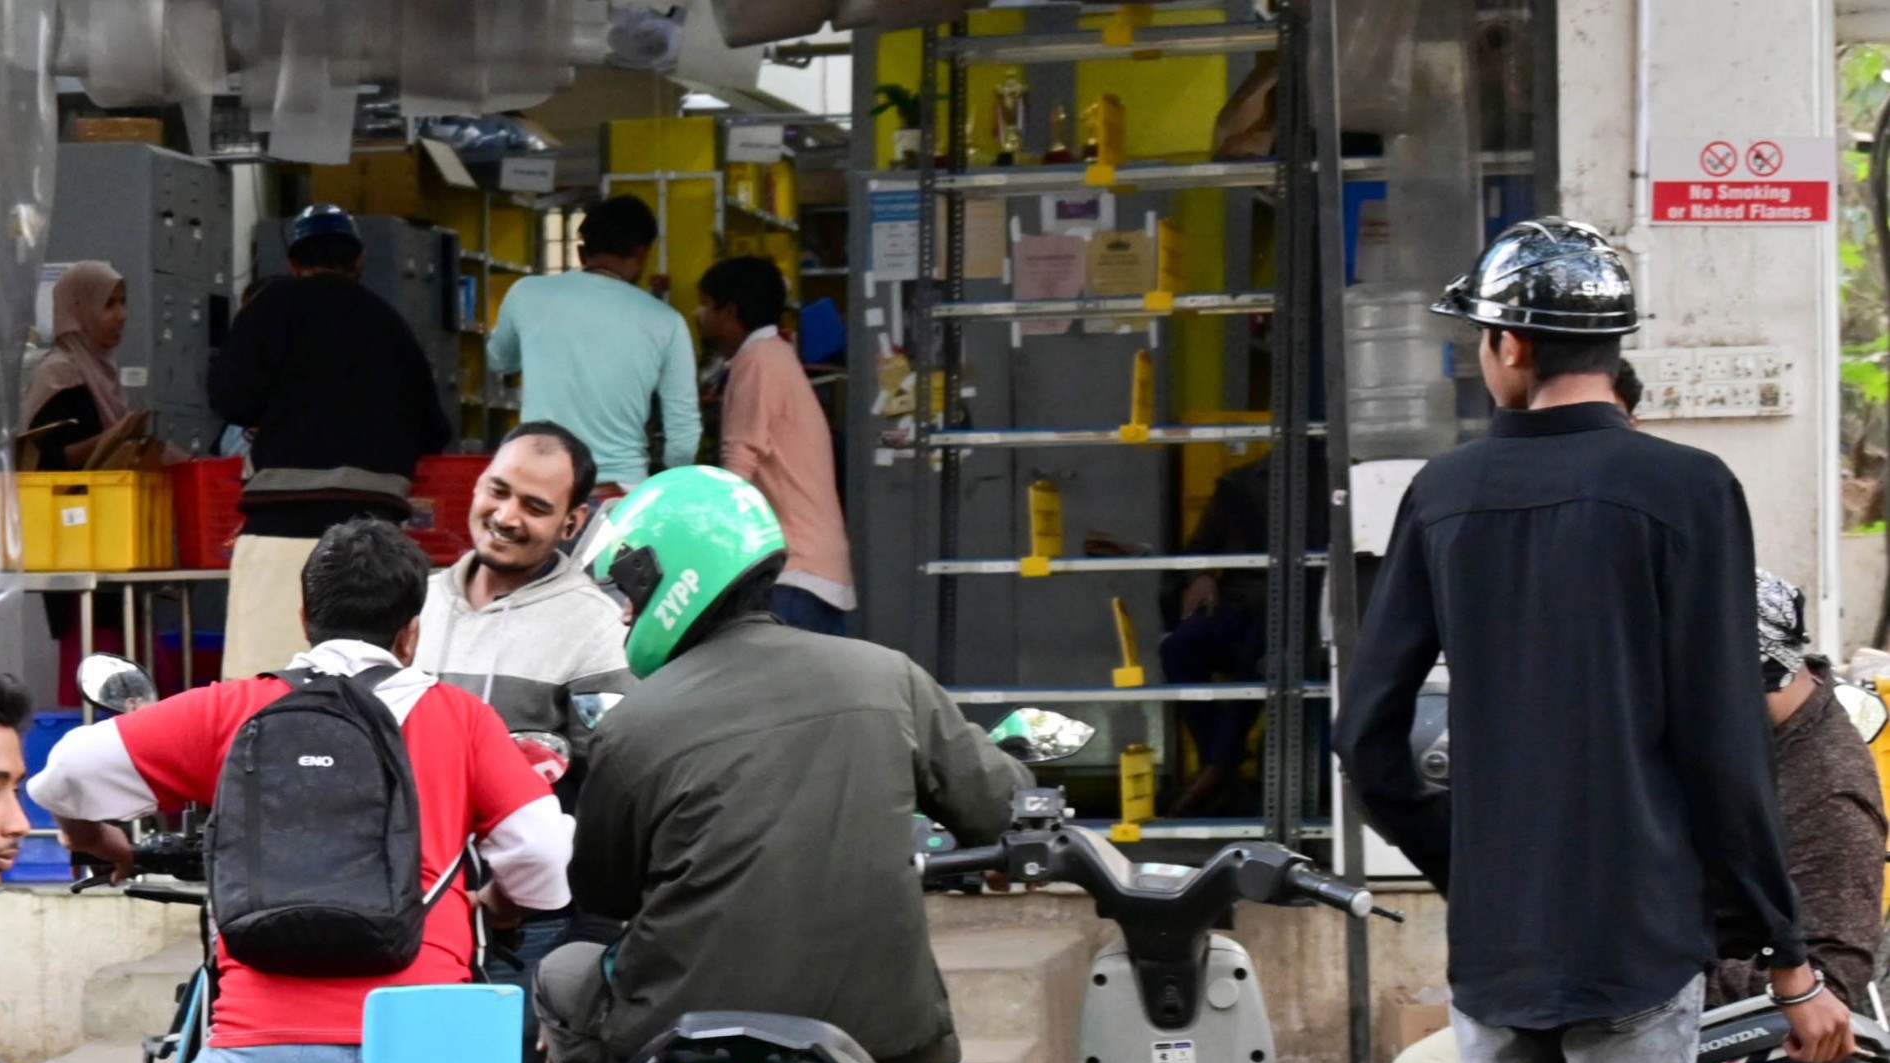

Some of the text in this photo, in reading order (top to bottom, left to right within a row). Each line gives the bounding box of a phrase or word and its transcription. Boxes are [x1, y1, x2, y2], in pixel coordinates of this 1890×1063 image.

[1689, 185, 1791, 203] No Smoking
[1667, 204, 1812, 219] or Naked Flames
[653, 568, 700, 631] ZYPP
